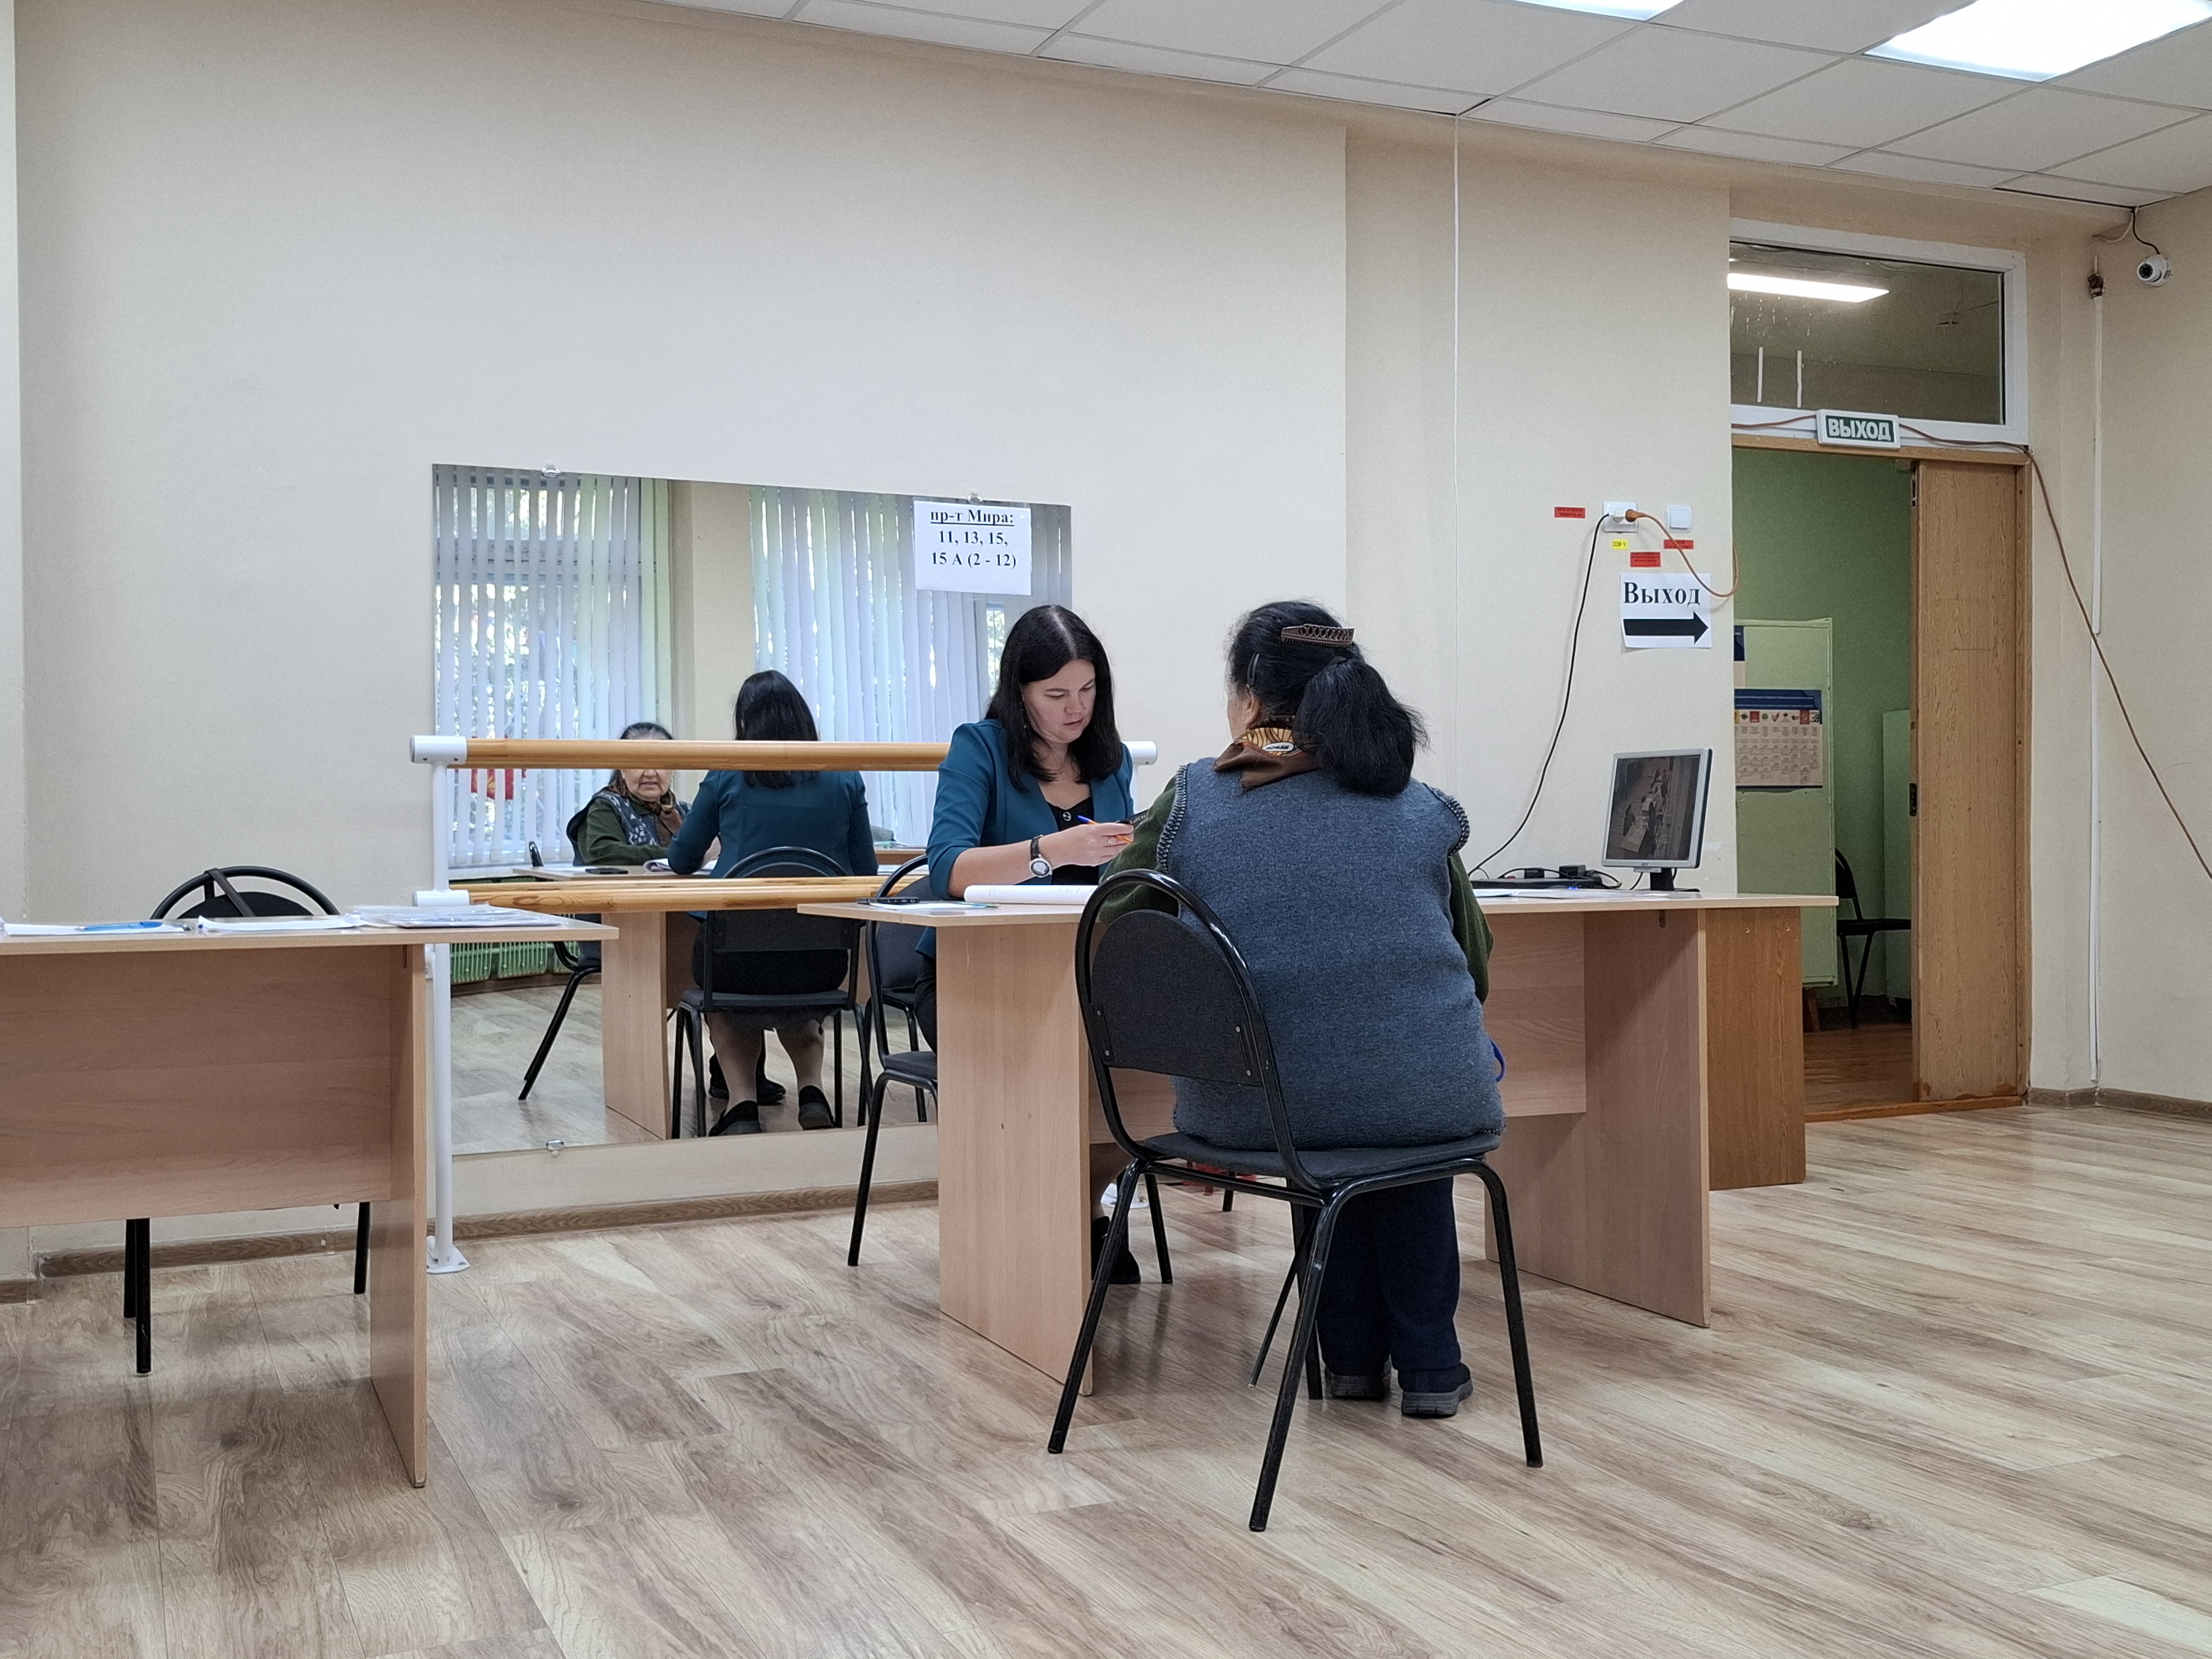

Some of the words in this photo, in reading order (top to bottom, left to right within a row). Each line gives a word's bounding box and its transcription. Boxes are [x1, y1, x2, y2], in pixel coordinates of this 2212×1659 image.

[1828, 418, 1891, 441] ВЫХОД
[931, 511, 963, 524] пр-т
[968, 509, 1013, 525] Мира:
[940, 530, 959, 546] 11,
[964, 531, 983, 546] 13,
[989, 532, 1008, 547] 15,
[932, 551, 947, 565] 15
[952, 553, 962, 565] А
[968, 553, 981, 569] (2
[996, 554, 1016, 569] 12)
[1623, 582, 1700, 607] Выход
